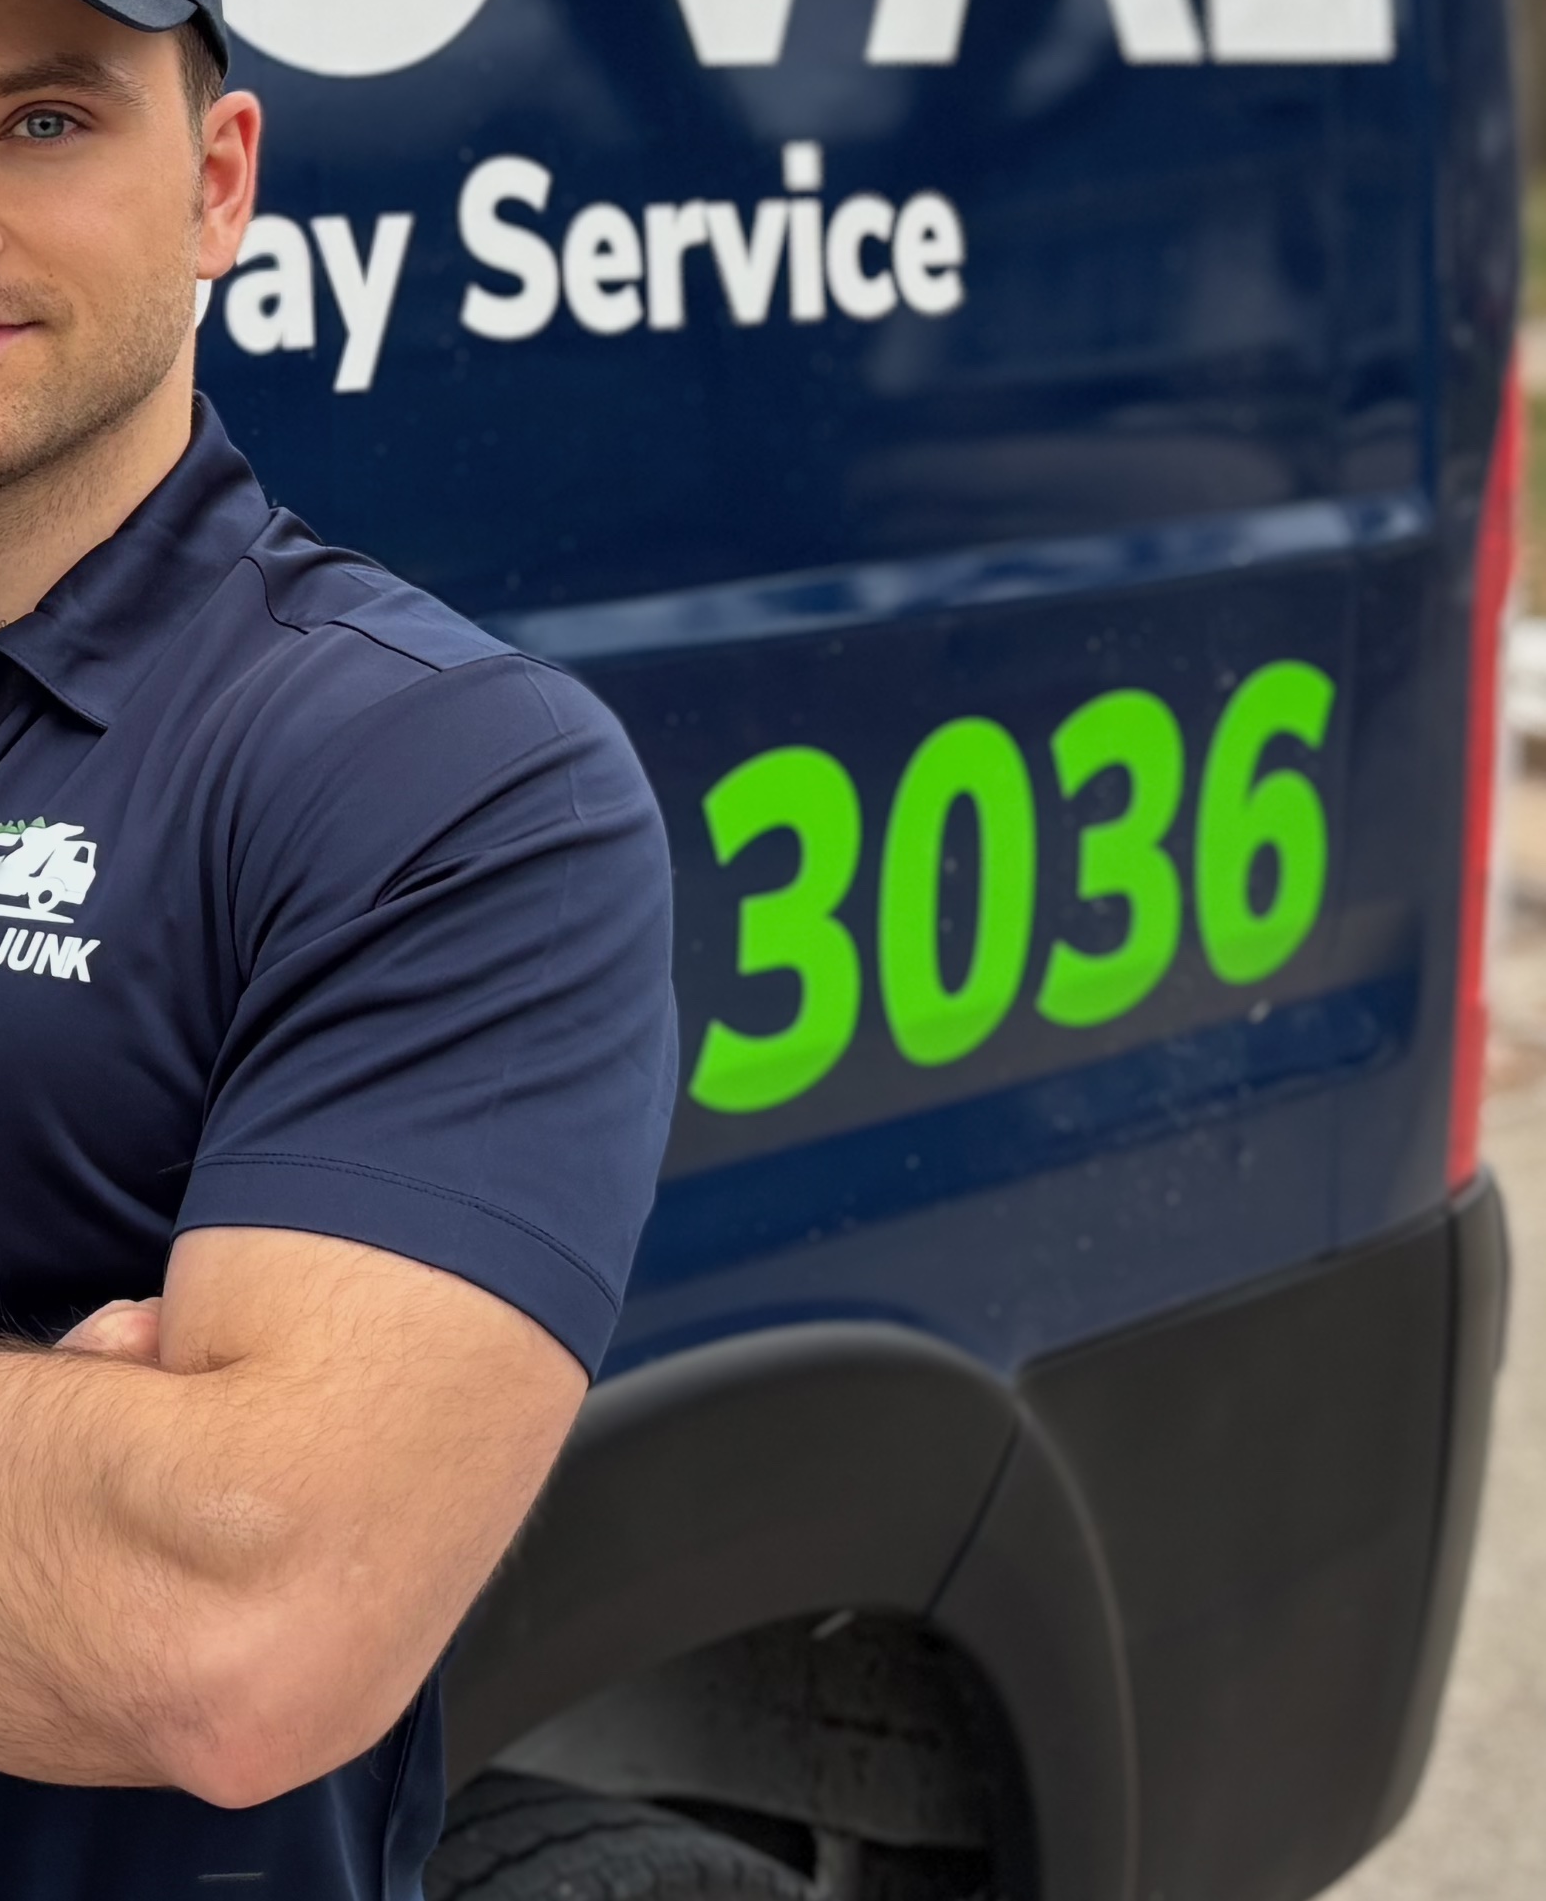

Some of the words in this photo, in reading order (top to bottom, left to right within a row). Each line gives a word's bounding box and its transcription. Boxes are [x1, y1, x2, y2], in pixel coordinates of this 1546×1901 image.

[195, 210, 414, 393] ay
[458, 142, 965, 342] Service
[687, 660, 1336, 1113] 3036
